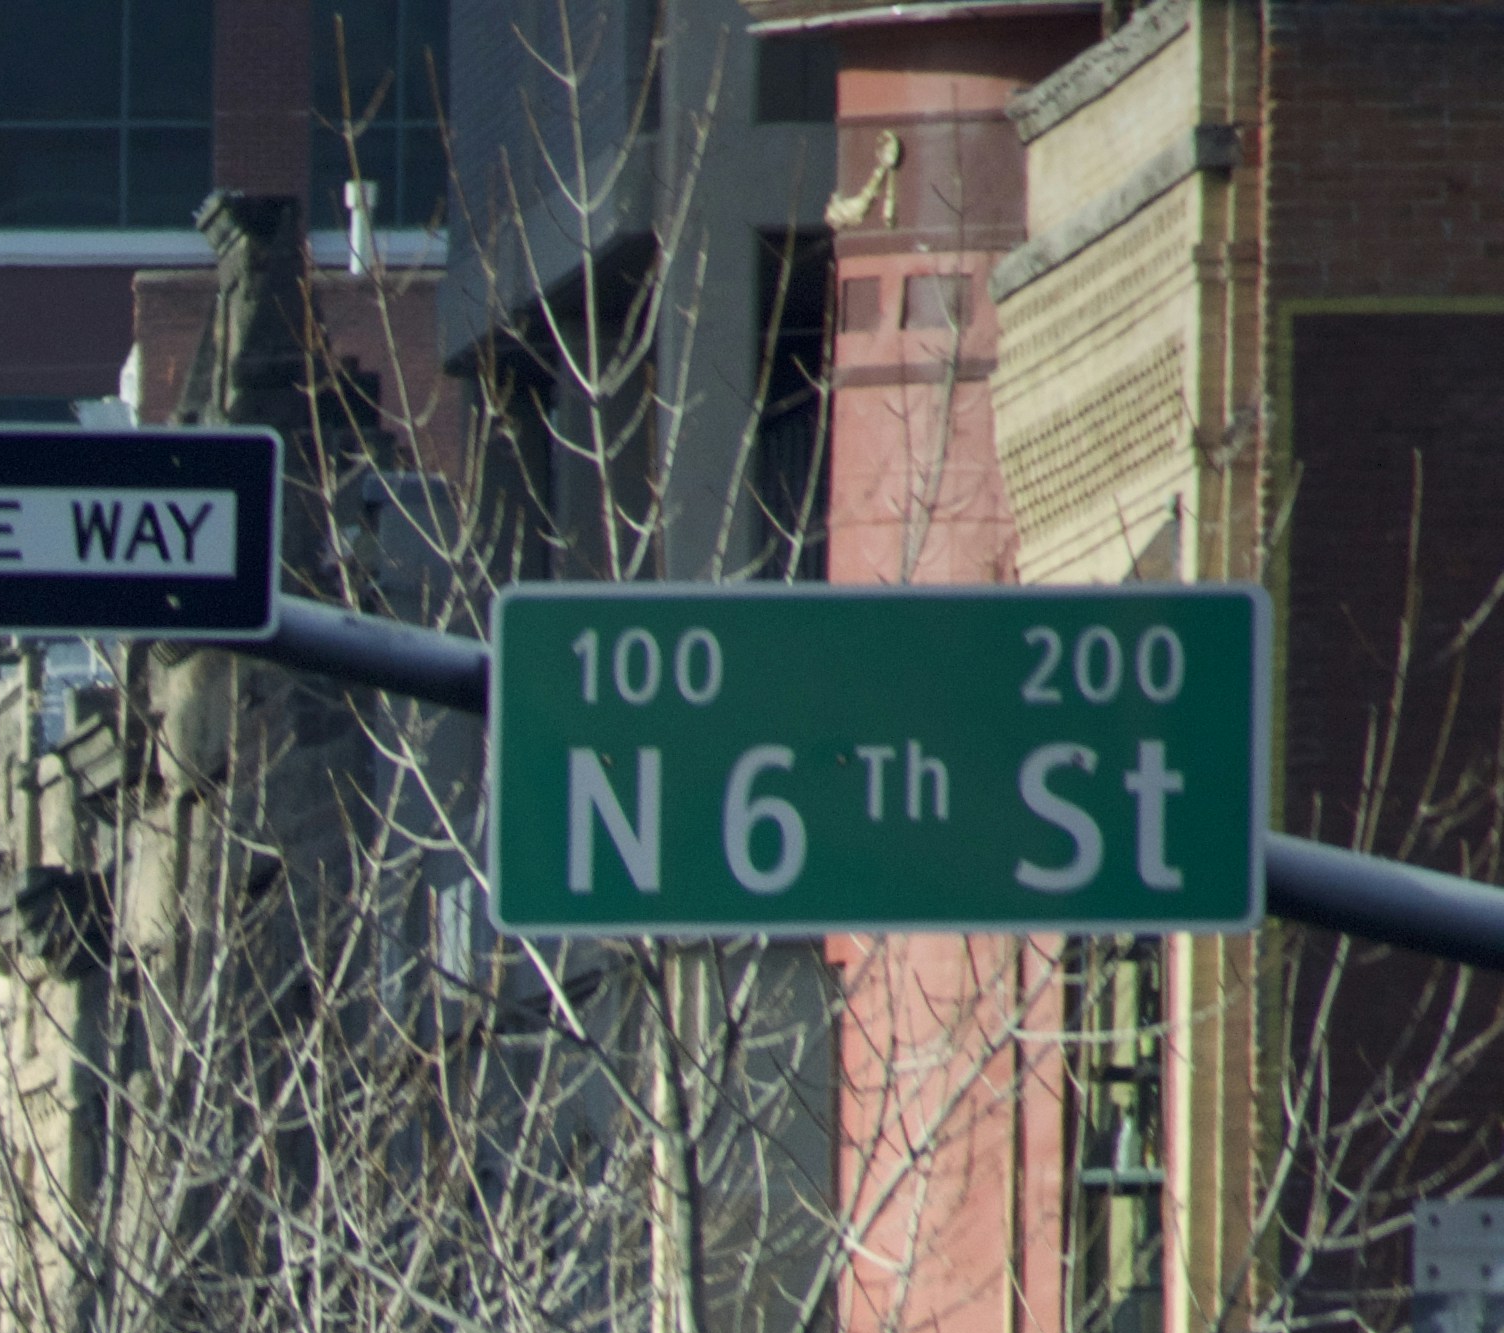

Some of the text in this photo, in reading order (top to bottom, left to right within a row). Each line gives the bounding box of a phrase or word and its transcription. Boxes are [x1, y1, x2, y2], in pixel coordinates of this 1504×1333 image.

[72, 499, 214, 563] WAY
[570, 624, 1185, 704] 100 200
[568, 738, 1185, 894] N 6 Th St
